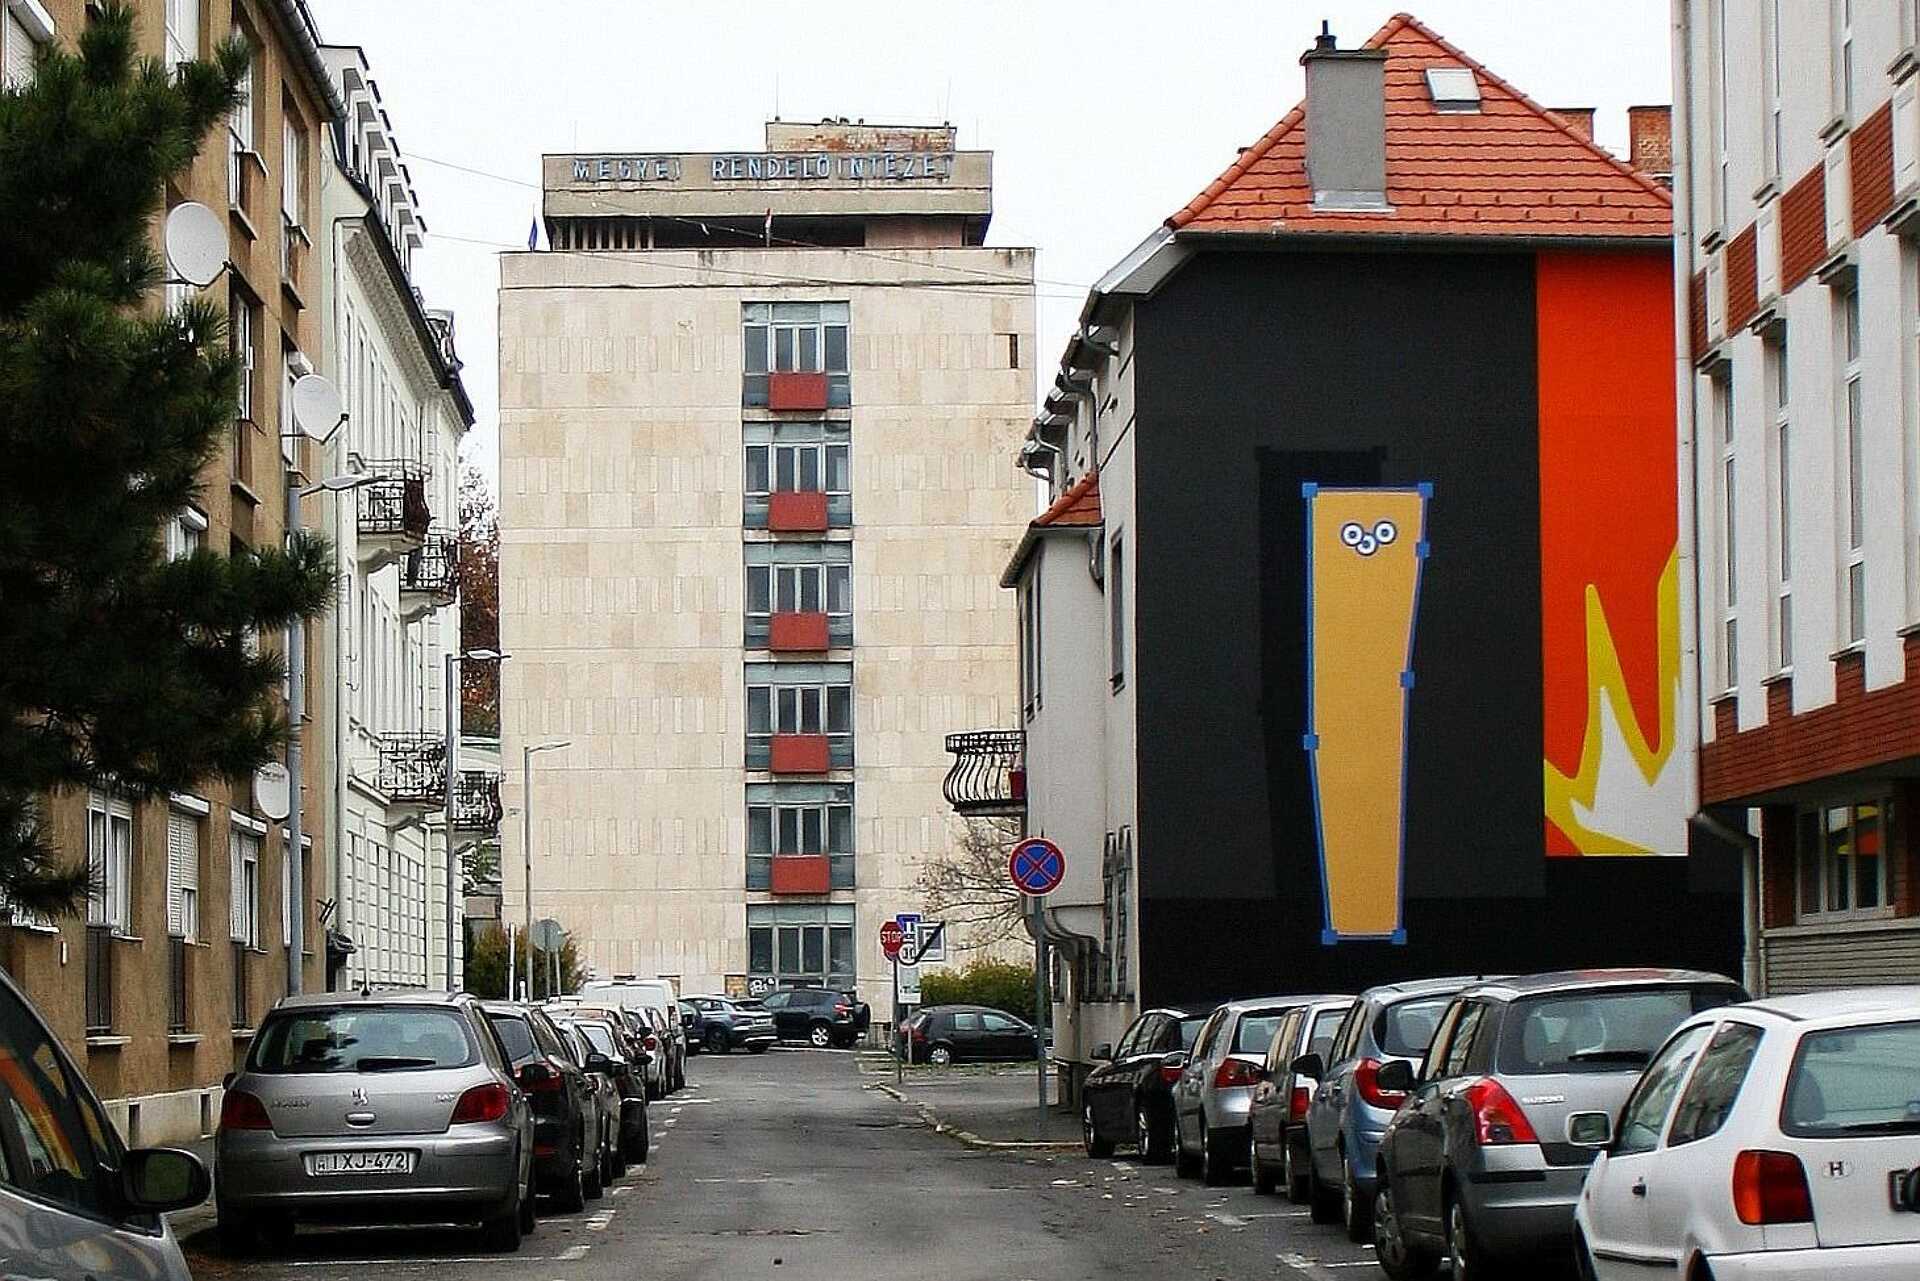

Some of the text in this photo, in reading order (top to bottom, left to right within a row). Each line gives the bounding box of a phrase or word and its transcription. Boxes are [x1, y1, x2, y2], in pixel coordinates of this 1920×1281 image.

[573, 158, 682, 179] MEGYEI
[881, 930, 903, 944] STOP
[334, 1152, 405, 1170] IXJ-472
[1829, 1160, 1843, 1176] H
